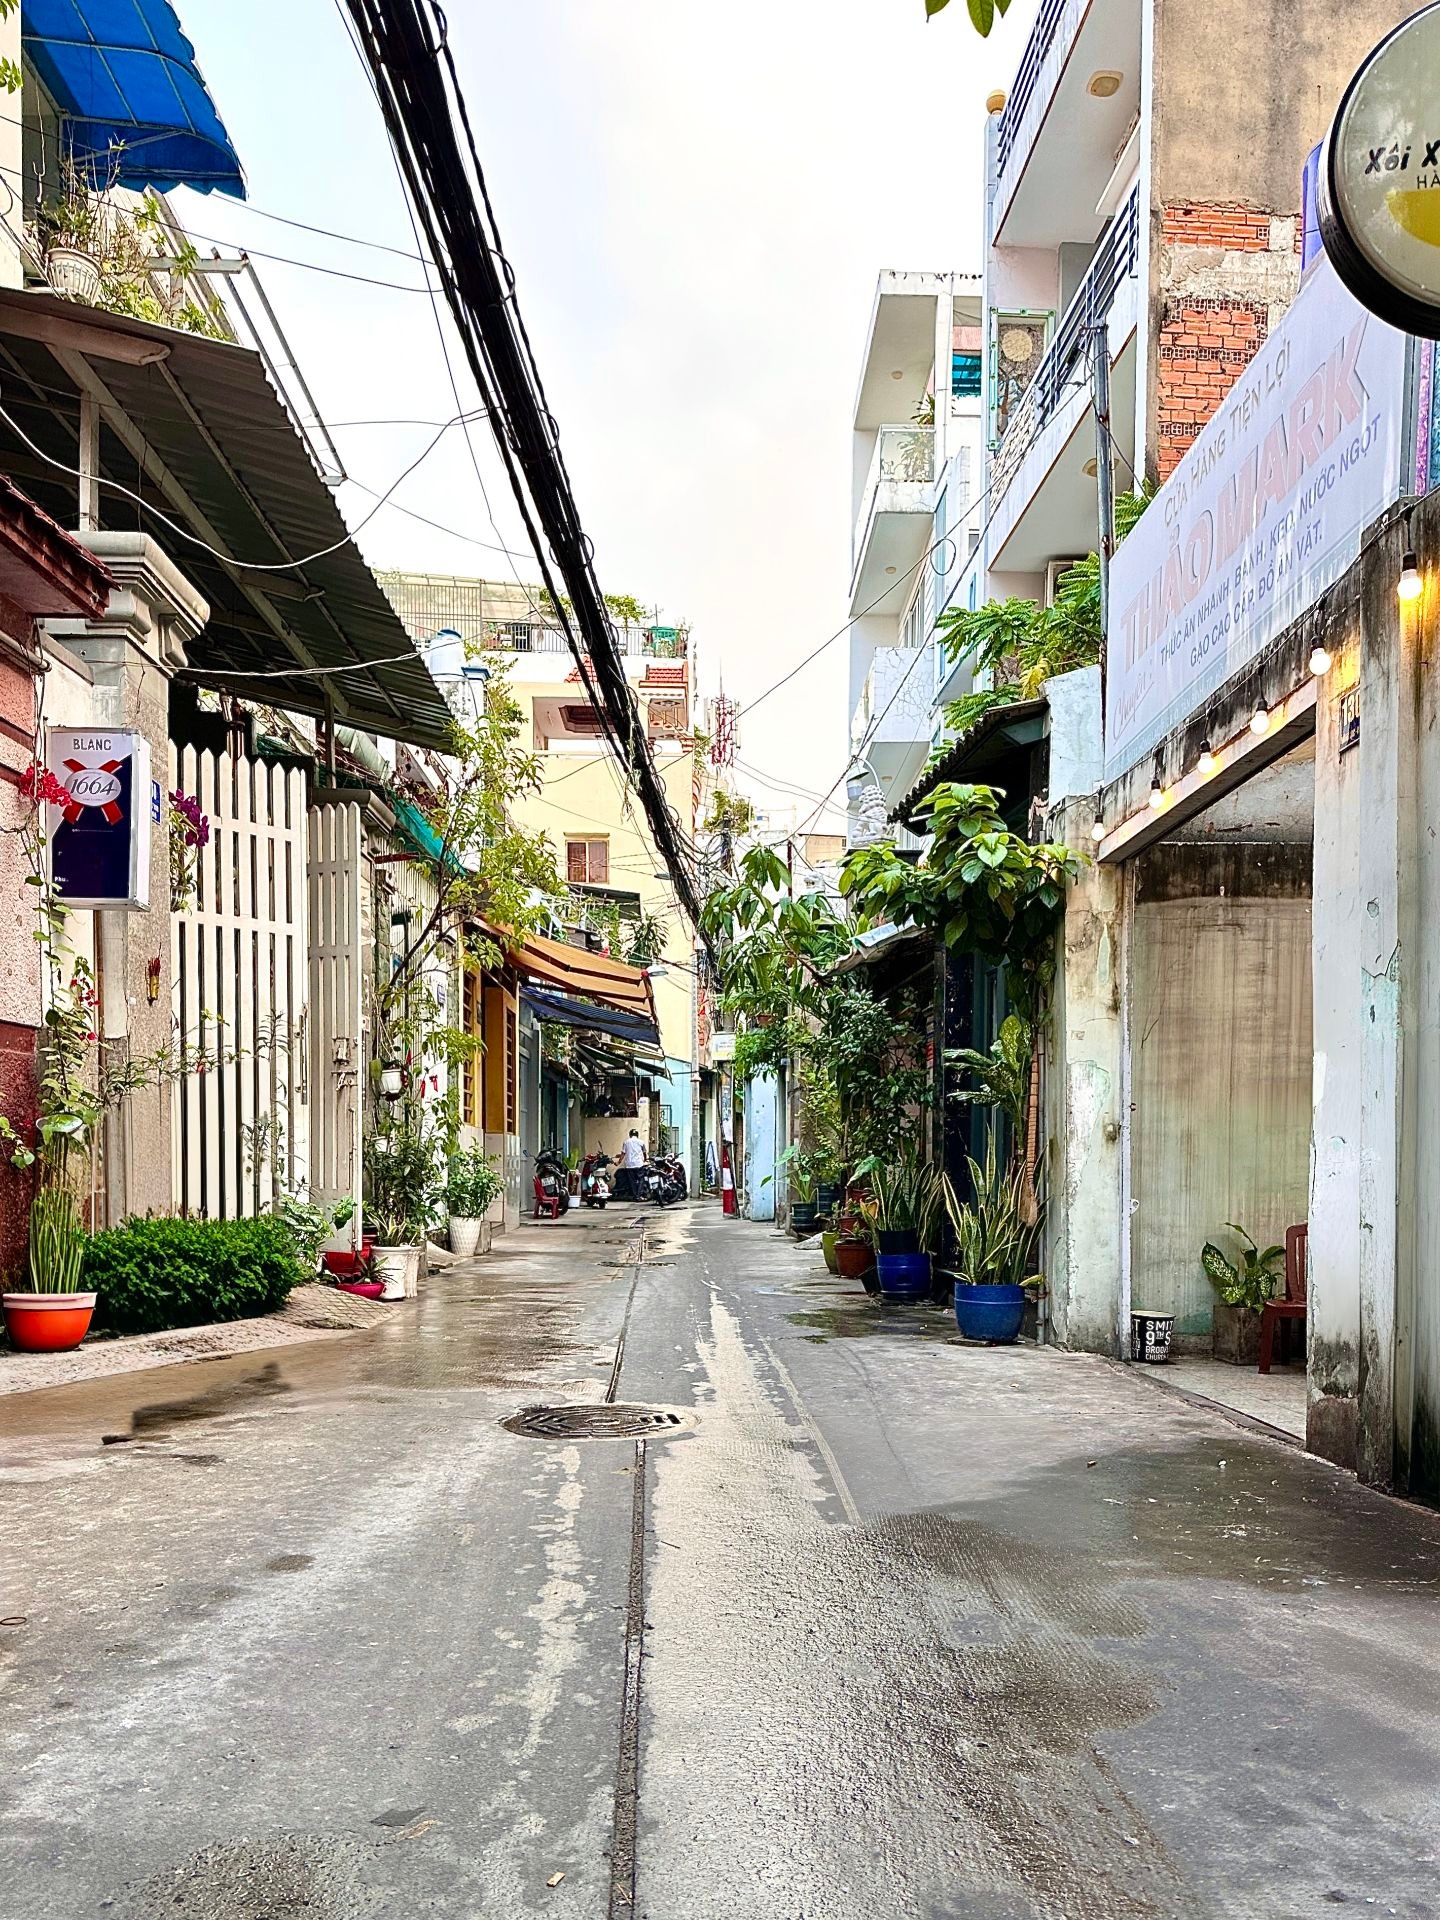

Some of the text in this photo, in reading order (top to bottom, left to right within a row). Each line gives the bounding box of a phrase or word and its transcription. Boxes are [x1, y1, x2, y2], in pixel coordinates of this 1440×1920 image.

[1364, 142, 1411, 175] Xôi
[1190, 429, 1226, 489] HÀNG
[1229, 380, 1262, 441] TIỆN
[1265, 338, 1291, 397] LỢI
[1299, 463, 1336, 521] NƯỚC
[1339, 413, 1382, 479] NGỌT
[1120, 508, 1214, 674] THẢO
[1215, 311, 1370, 573] MARK
[1190, 633, 1210, 668] GẠO
[1211, 612, 1231, 647] CAO
[1258, 559, 1275, 600] ĐỒ
[70, 776, 118, 796] 1664
[73, 738, 112, 751] BLANC
